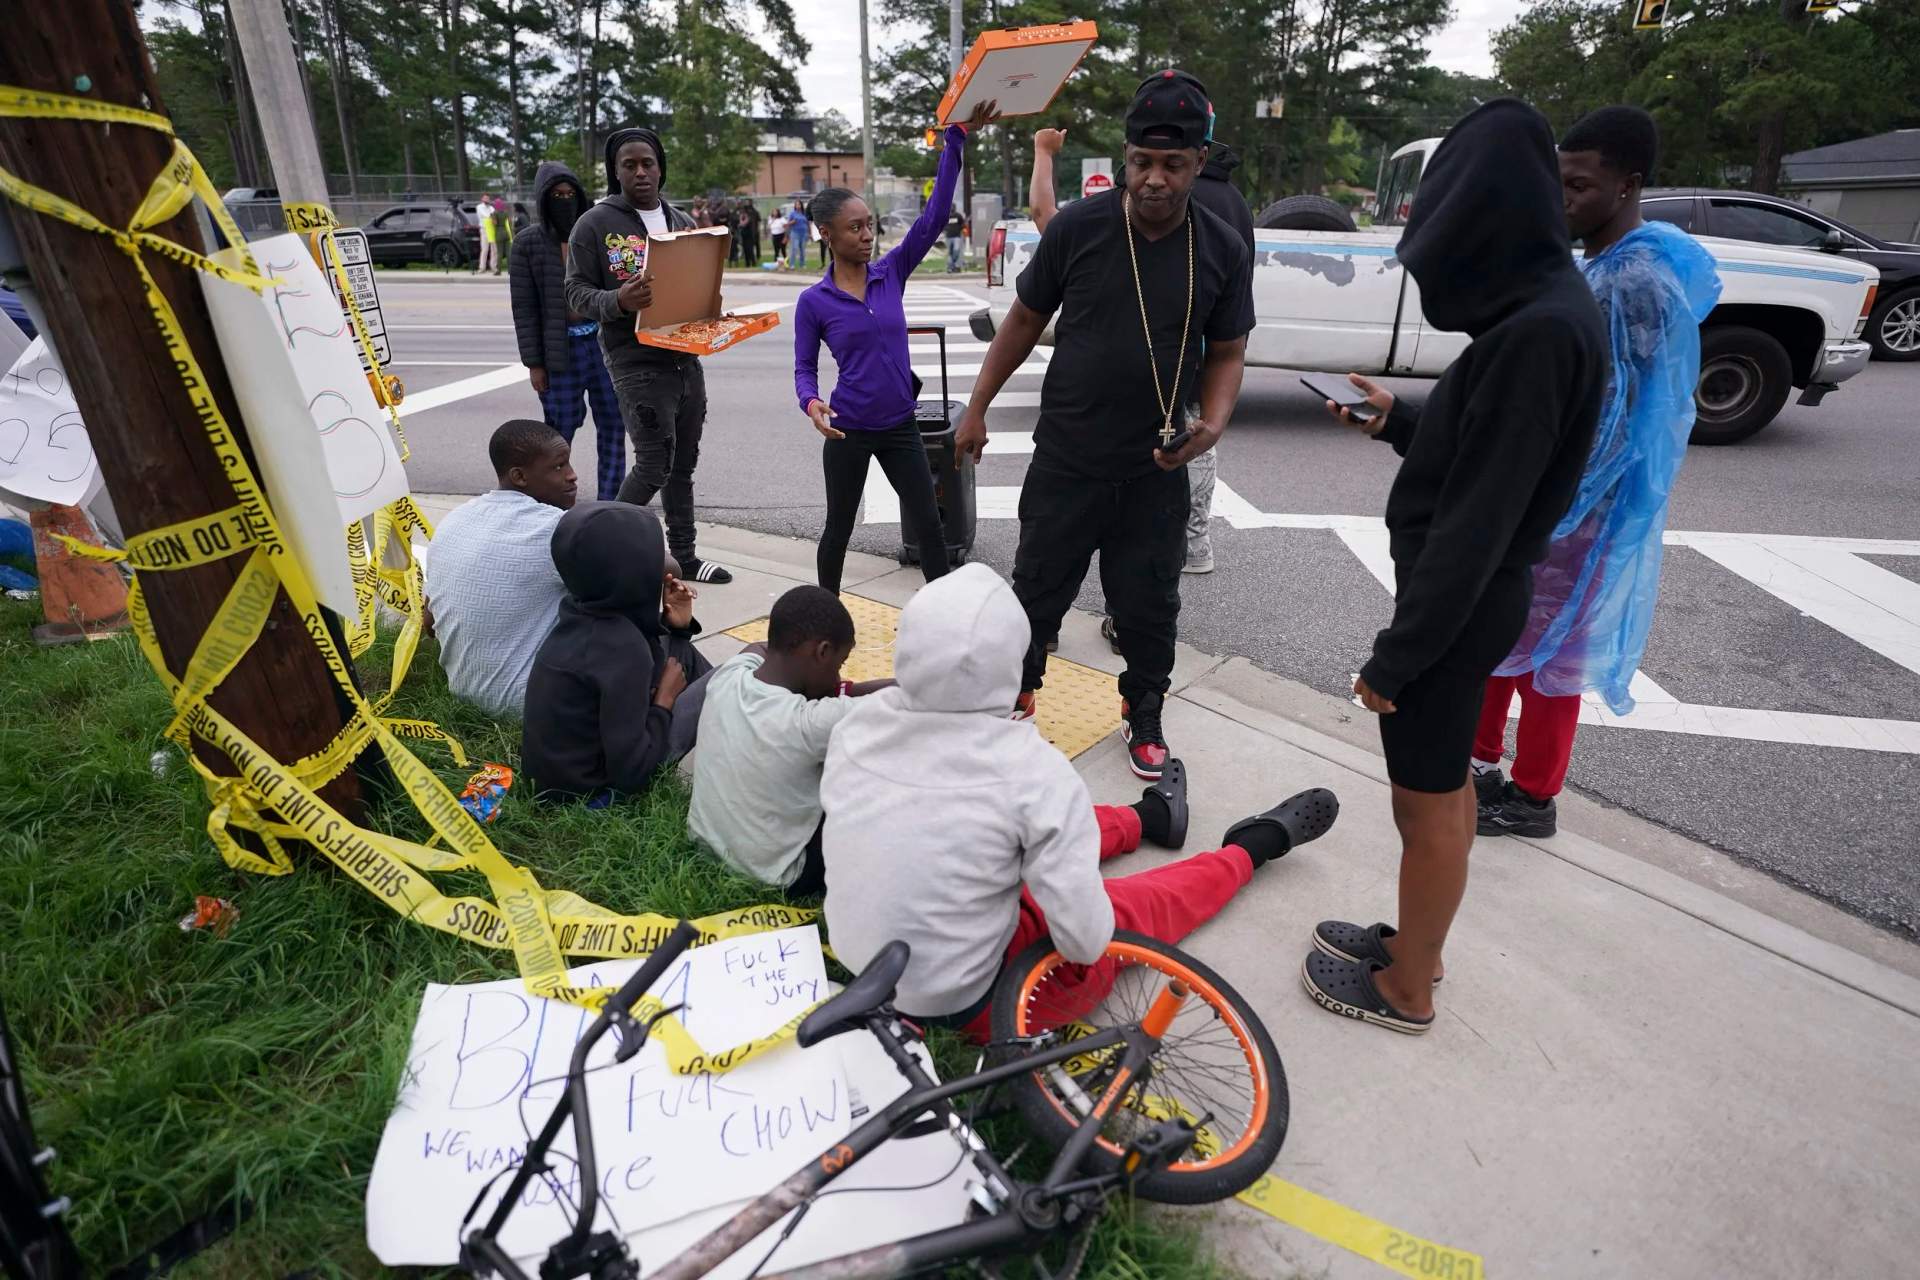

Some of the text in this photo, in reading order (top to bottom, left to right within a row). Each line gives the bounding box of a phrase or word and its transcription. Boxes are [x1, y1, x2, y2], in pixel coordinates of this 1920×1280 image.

[250, 764, 284, 801] DO
[274, 786, 325, 832] LINE
[316, 820, 409, 897] SHERIFF'S
[559, 923, 579, 950] DO
[578, 923, 617, 951] LINE
[1314, 992, 1366, 1019] crocs
[720, 1079, 836, 1157] CHOW
[424, 1129, 471, 1159] WE
[466, 1146, 530, 1173] WAN
